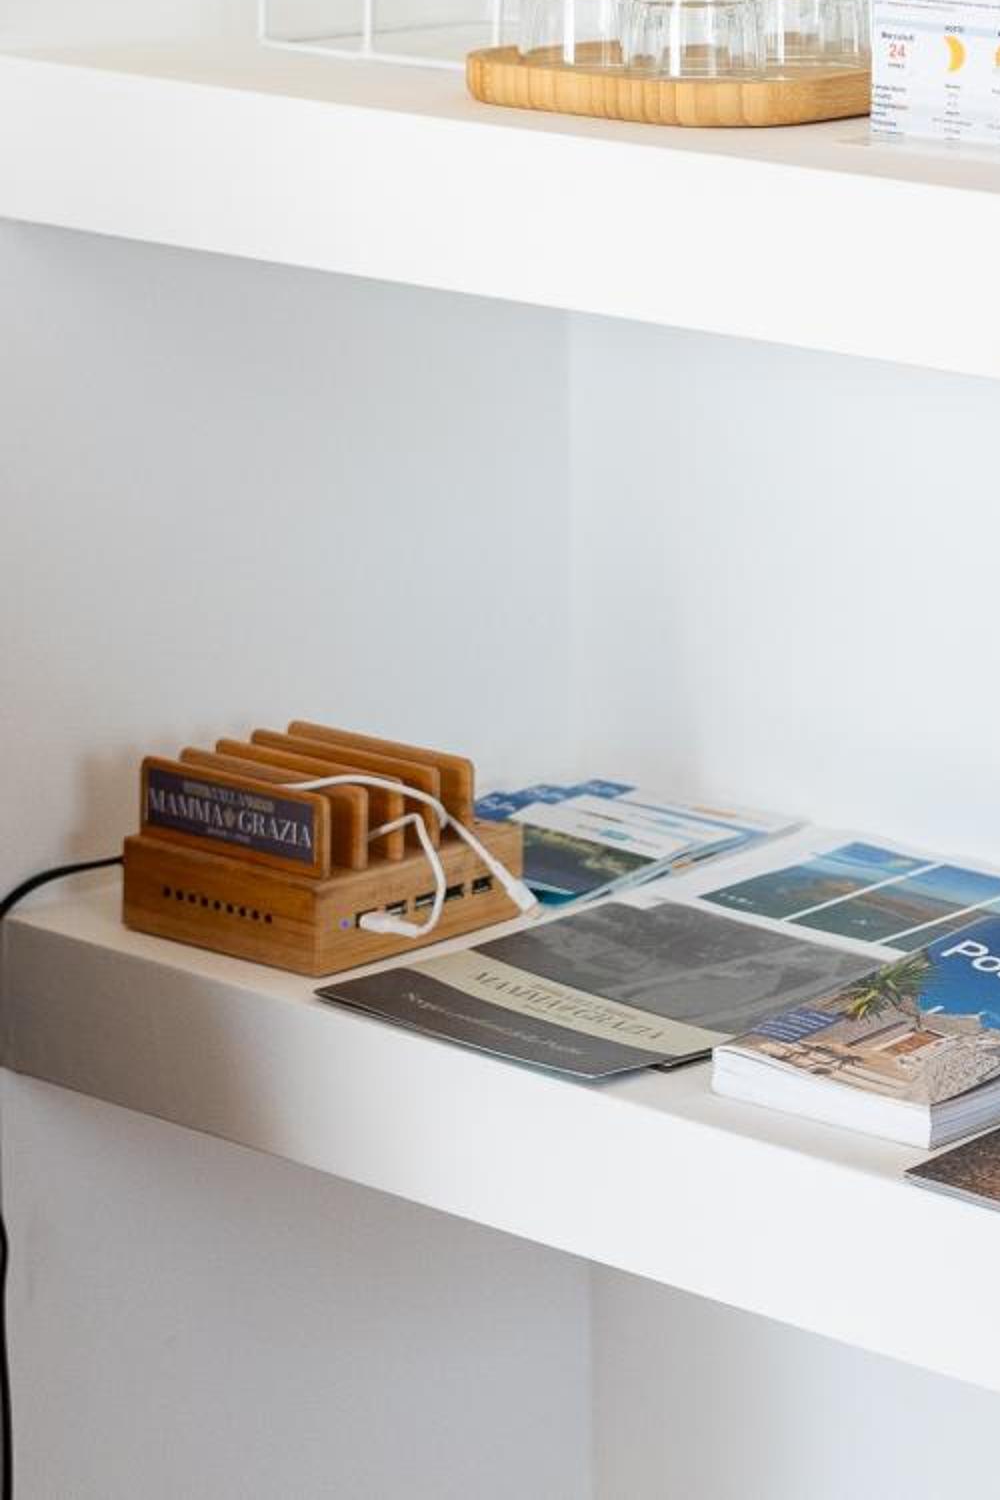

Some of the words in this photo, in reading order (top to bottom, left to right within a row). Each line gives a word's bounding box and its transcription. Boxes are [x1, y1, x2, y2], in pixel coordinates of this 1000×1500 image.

[889, 43, 906, 58] 24
[149, 787, 223, 827] MAMMA
[238, 809, 312, 849] GRAZIA
